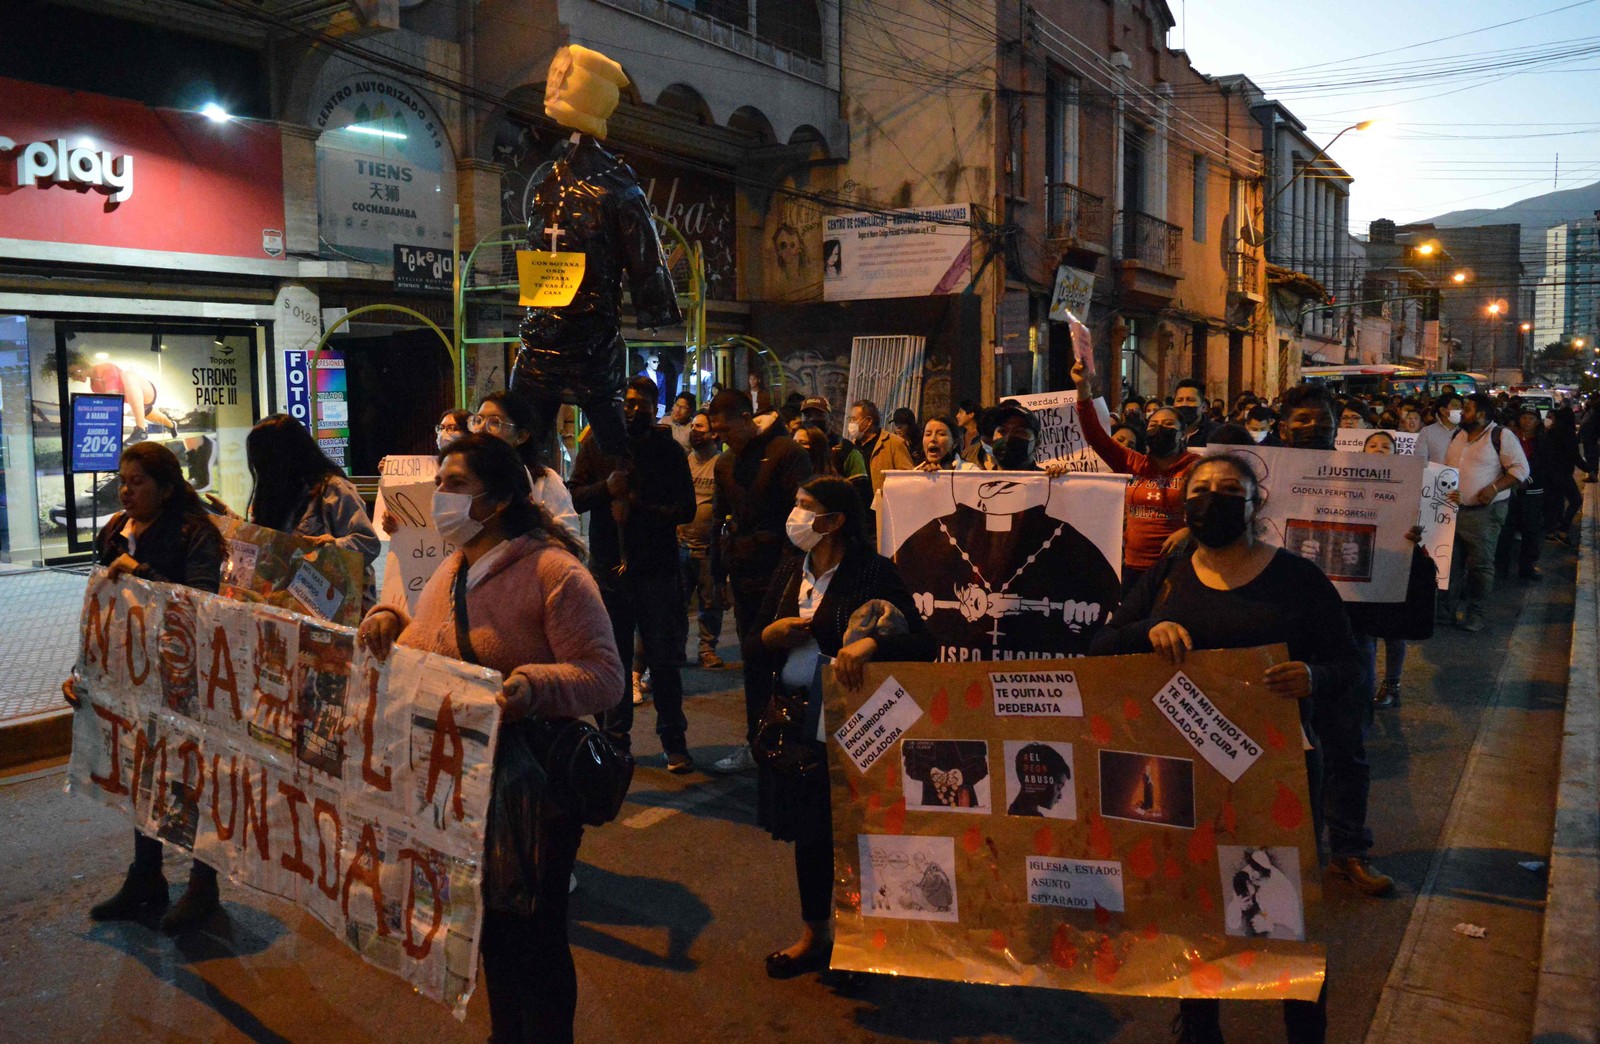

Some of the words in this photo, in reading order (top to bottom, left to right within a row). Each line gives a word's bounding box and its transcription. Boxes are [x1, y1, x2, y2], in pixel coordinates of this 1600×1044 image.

[317, 85, 352, 127] CENTRO
[355, 81, 426, 120] AUTORIZADO
[17, 138, 134, 203] play
[354, 160, 412, 182] TIENS
[369, 182, 400, 202] 天獅
[352, 202, 417, 219] COCHABAMBA
[828, 218, 846, 230] CENTRO
[847, 218, 853, 229] DE
[293, 306, 318, 326] 0128
[210, 356, 235, 366] Topper
[192, 368, 237, 386] STRONG
[196, 388, 225, 406] PACE
[227, 388, 238, 406] III
[317, 392, 343, 401] NILLADO
[1028, 397, 1058, 406] verdad
[91, 411, 109, 419] MAMÁ
[1040, 425, 1080, 444] NAMOS
[77, 436, 117, 452] -20%
[384, 458, 420, 476] IGLESIA
[1292, 486, 1323, 496] CADENA
[1324, 489, 1364, 500] PERPETUA
[1374, 492, 1395, 501] PARA
[384, 492, 426, 528] NO
[413, 539, 436, 558] de
[298, 574, 320, 597] OBISPOS
[934, 646, 982, 662] ISPO
[992, 674, 1007, 683] LA
[1010, 674, 1054, 683] SOTANA
[1055, 674, 1074, 683] NO
[996, 688, 1008, 698] TE
[1011, 688, 1045, 699] QUITA
[1047, 688, 1062, 698] LO
[84, 592, 150, 686] NO
[207, 625, 242, 722] A
[361, 664, 464, 822] LA
[998, 703, 1061, 713] PEDERASTA
[1177, 676, 1199, 700] CON
[1198, 698, 1215, 716] MIS
[1212, 714, 1242, 741] HIJOS
[1240, 739, 1258, 756] NO
[837, 712, 864, 740] IGLESIA
[845, 698, 898, 750] ENCUBRIDORA,
[894, 688, 905, 700] ES
[1158, 695, 1205, 748] VIOLADOR
[1168, 685, 1181, 700] TE
[1179, 698, 1208, 734] METAS,
[1210, 732, 1238, 760] CURA
[852, 737, 876, 760] IGUAL
[874, 724, 886, 738] DE
[860, 727, 903, 768] VIOLADORA
[1030, 753, 1040, 762] EL
[1024, 775, 1054, 785] ABUSO
[90, 702, 443, 961] IMPUNIDAD
[1031, 878, 1071, 889] ASUNTO
[1031, 894, 1088, 906] SEPARADO
